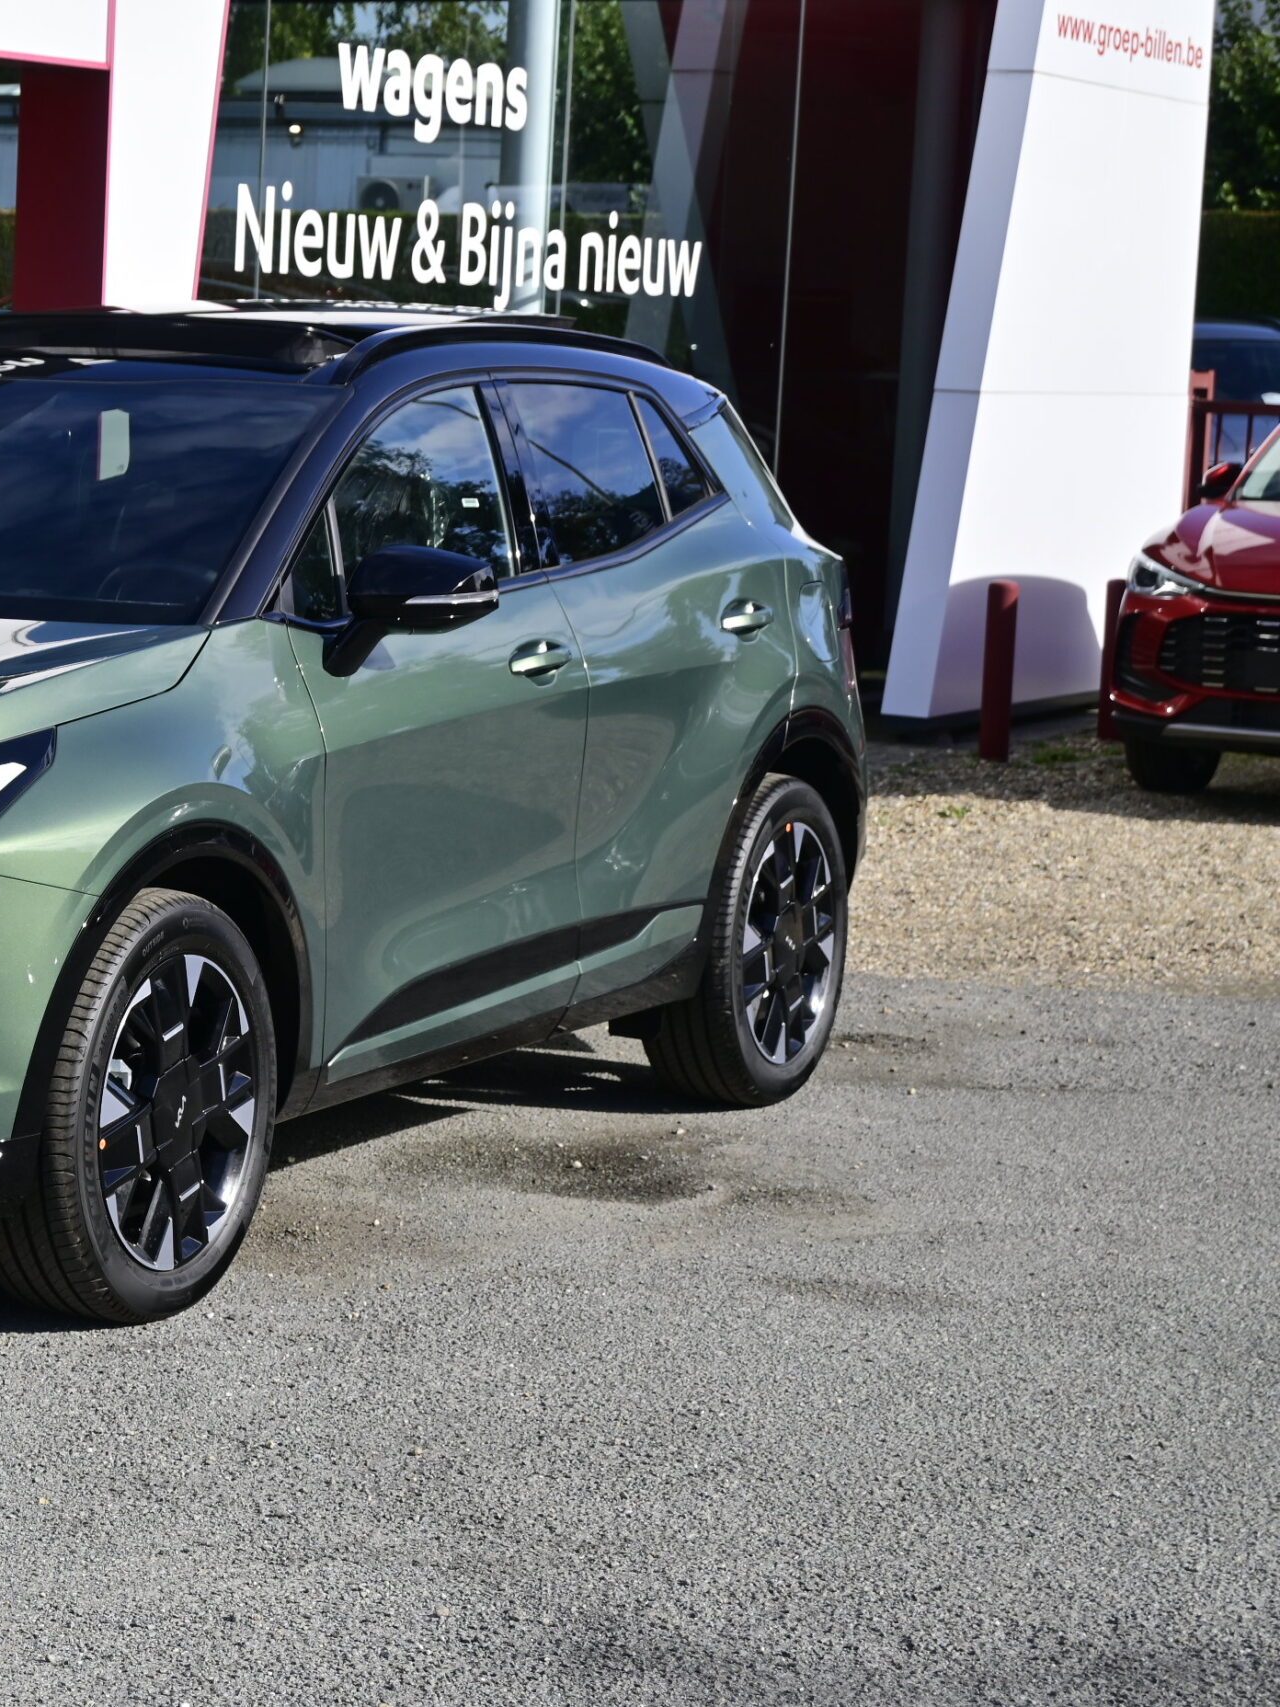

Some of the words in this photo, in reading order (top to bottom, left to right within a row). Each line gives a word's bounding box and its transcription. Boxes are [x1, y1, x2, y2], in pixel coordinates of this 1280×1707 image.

[1057, 13, 1203, 69] www.groep-billen.be
[234, 181, 402, 280] Nieuw
[411, 199, 447, 287] &
[459, 200, 567, 312] Bijna
[578, 210, 702, 298] nieuw
[84, 1072, 99, 1217] MICHELIN
